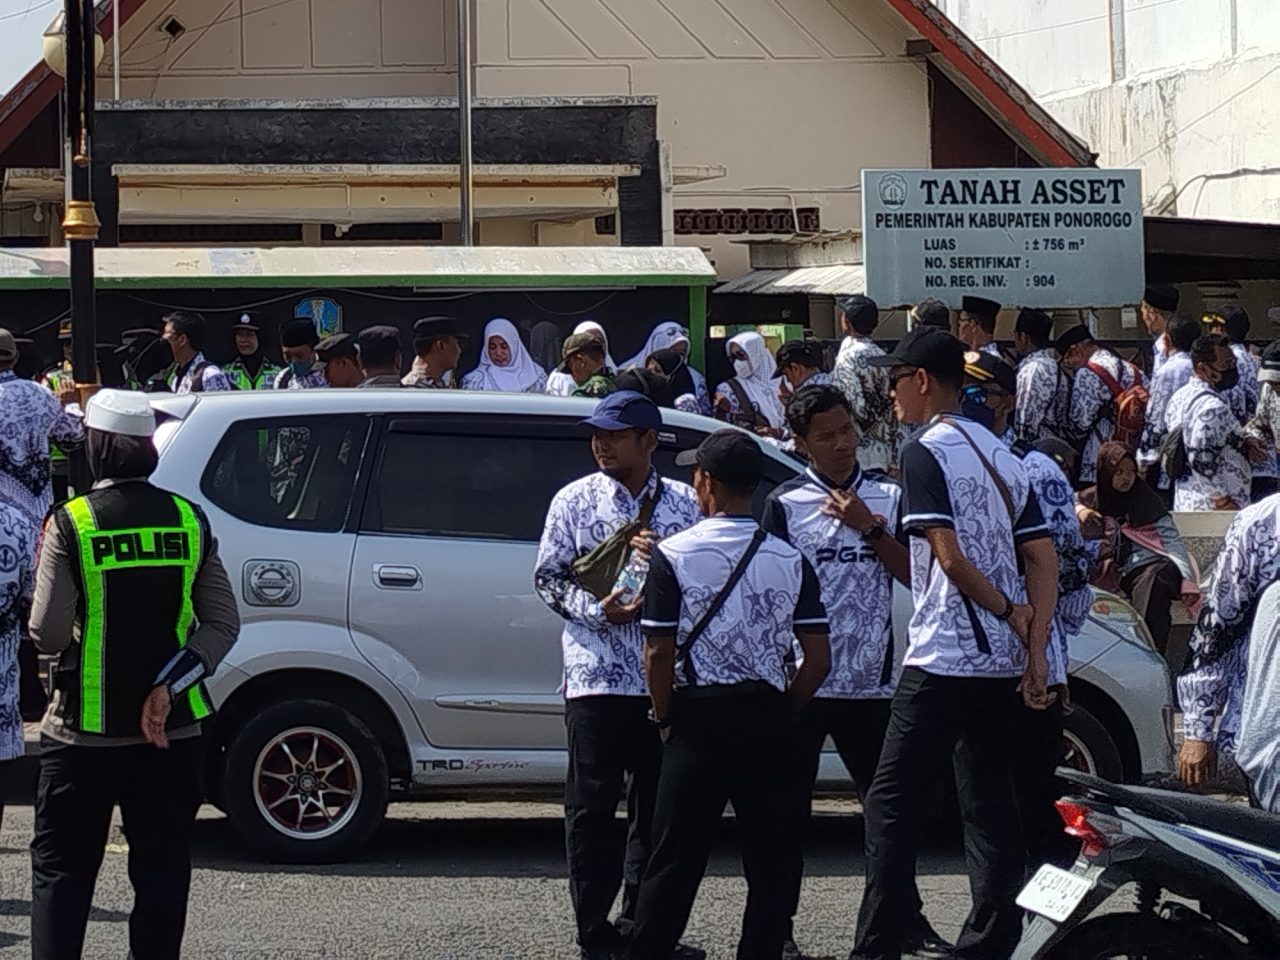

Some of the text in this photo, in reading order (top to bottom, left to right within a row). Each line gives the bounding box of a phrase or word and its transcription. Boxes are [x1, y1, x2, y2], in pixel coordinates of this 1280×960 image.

[919, 179, 1125, 205] TANAH ASSET
[875, 213, 1132, 229] PEMERINTAH KABUPATEN PONOROGO
[924, 239, 956, 251] LUAS
[1043, 238, 1065, 251] 756
[925, 257, 946, 269] NO.
[950, 257, 1020, 269] SERTIFIKAT
[925, 276, 947, 287] NO.
[950, 276, 979, 287] REG.
[983, 276, 1007, 287] INV.
[1033, 276, 1055, 287] 904
[91, 532, 190, 565] POLISI
[816, 545, 878, 565] PGR
[416, 759, 464, 770] TRD
